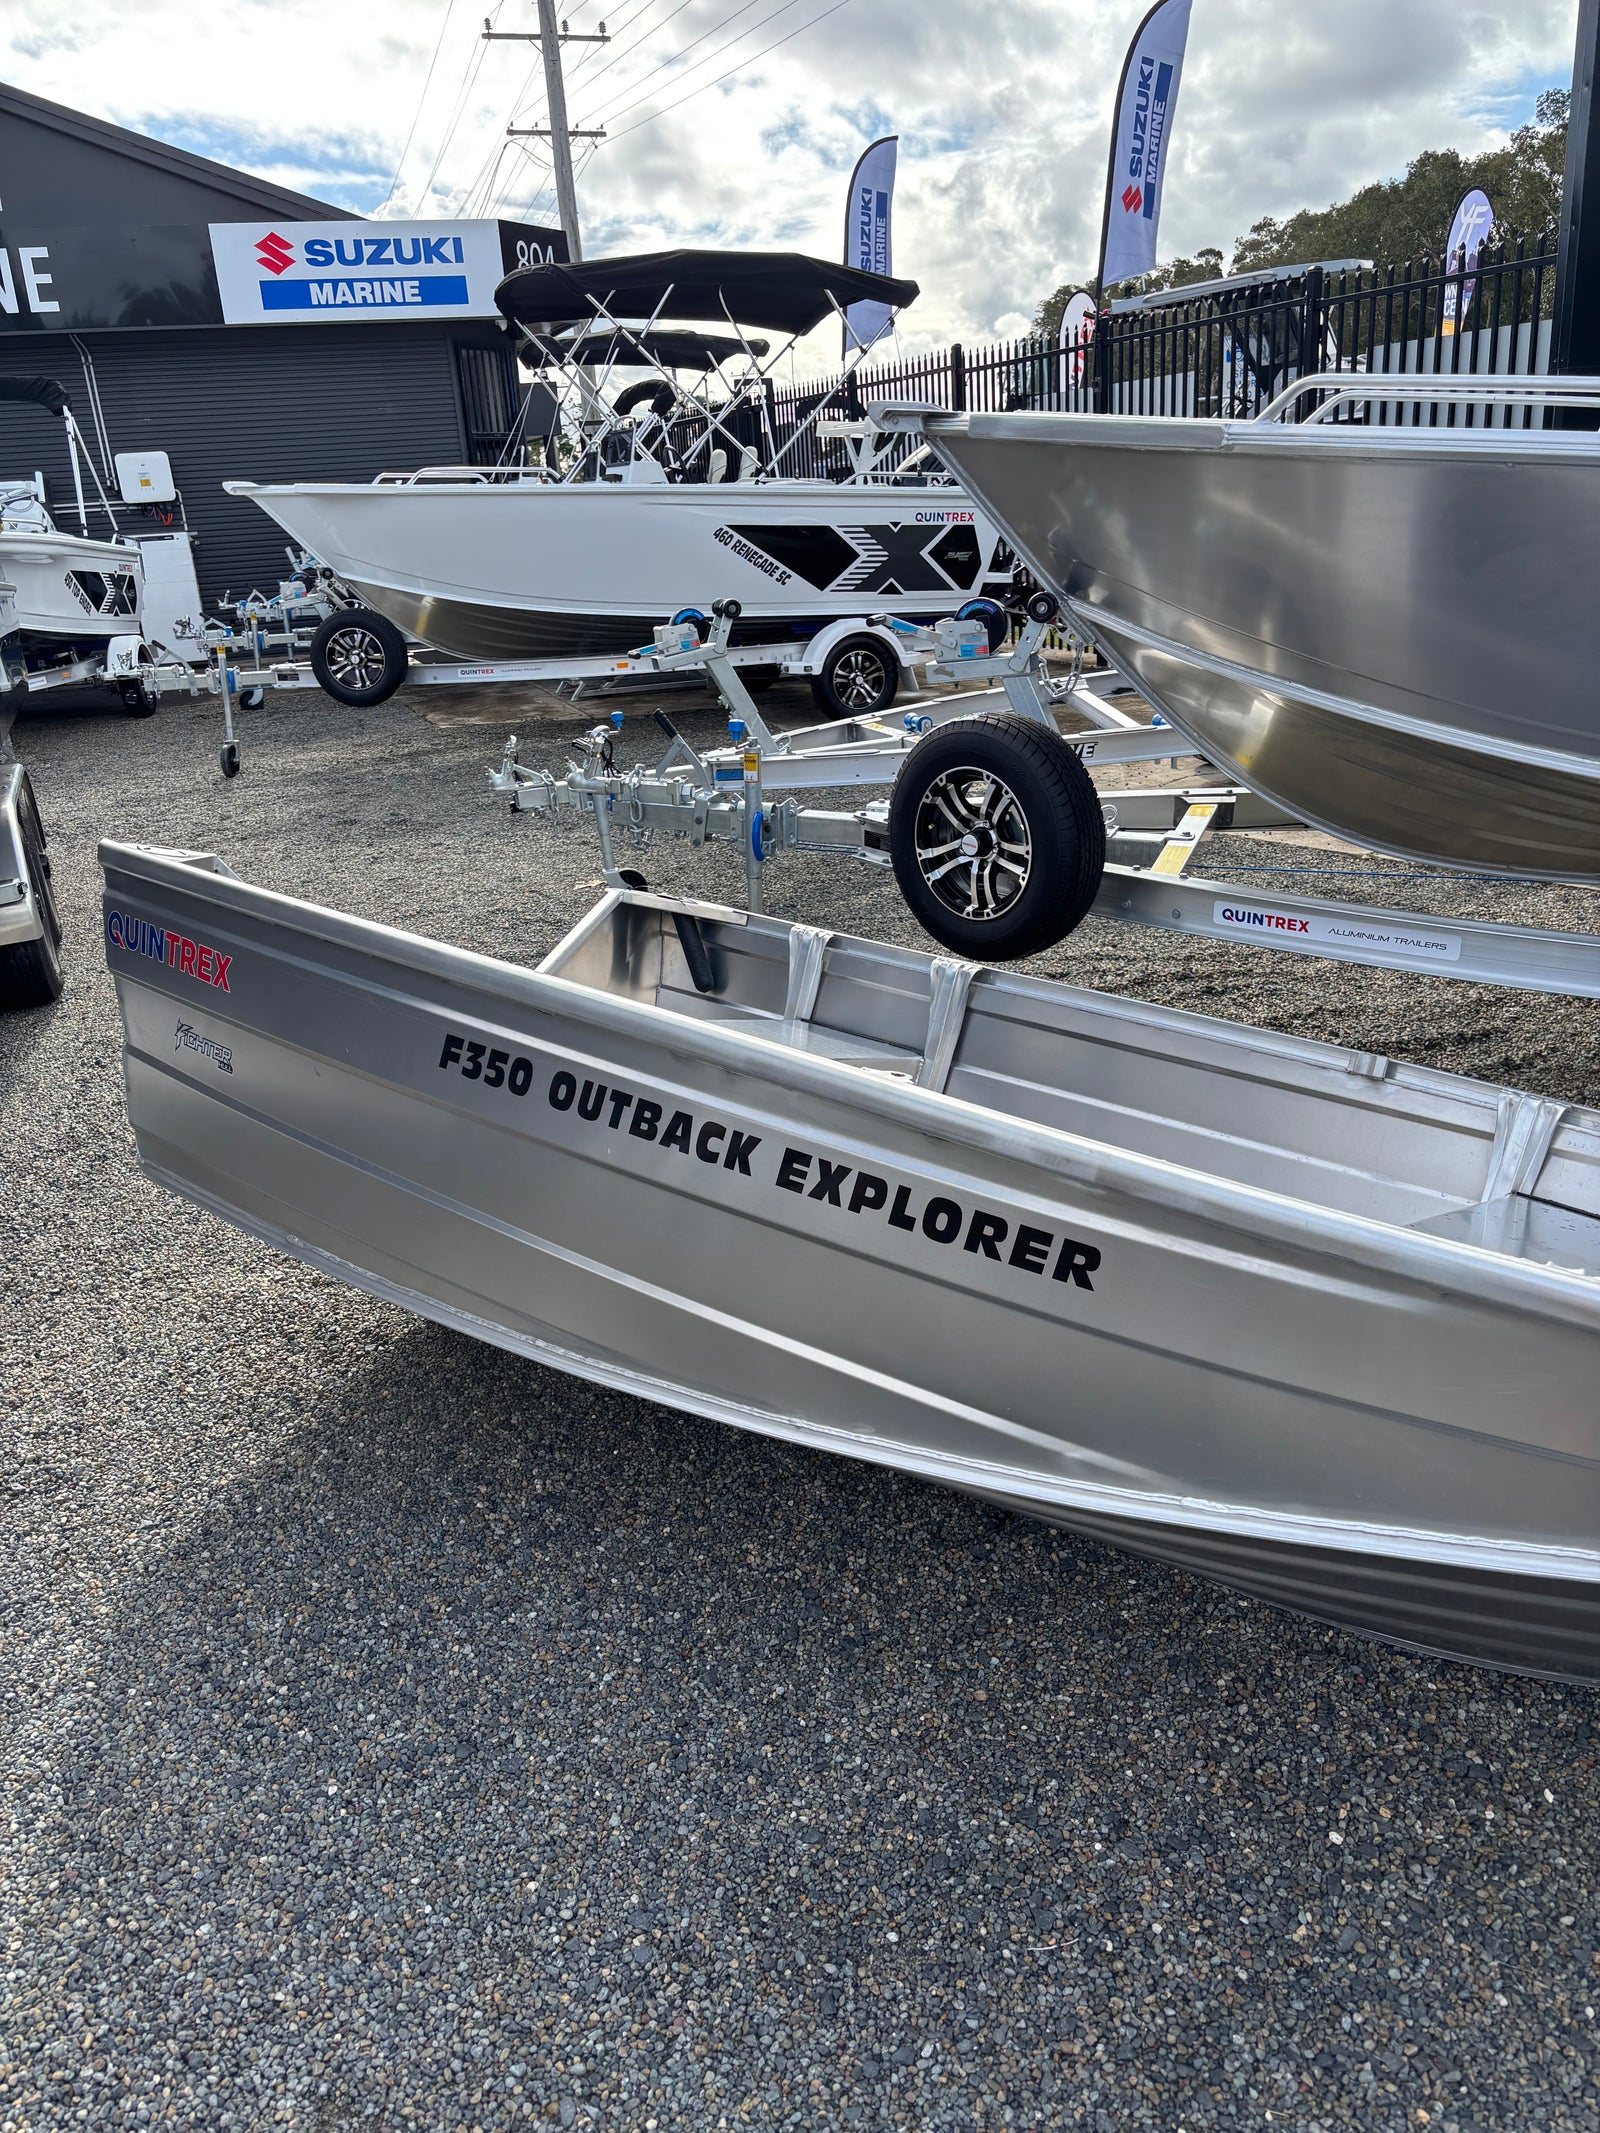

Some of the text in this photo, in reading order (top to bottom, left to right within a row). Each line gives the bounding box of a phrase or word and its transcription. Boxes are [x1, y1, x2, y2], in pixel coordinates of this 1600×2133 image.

[1129, 56, 1154, 178] SUZUKI
[1146, 100, 1165, 183] MARINE
[304, 237, 464, 267] SUZUKI
[861, 187, 872, 271] SUZUKI
[875, 217, 886, 275] MARINE
[309, 281, 422, 305] MARINE
[915, 512, 974, 522] QUINTREX
[713, 527, 792, 586] 460 RENEGADE SC
[108, 911, 232, 993] QUINTREX
[1222, 908, 1448, 951] QUINTREX ALUMINIUM TRAILERS
[174, 1017, 232, 1064] FIGHTER
[438, 1033, 1101, 1292] F350 OUTBACK EXPLORER
